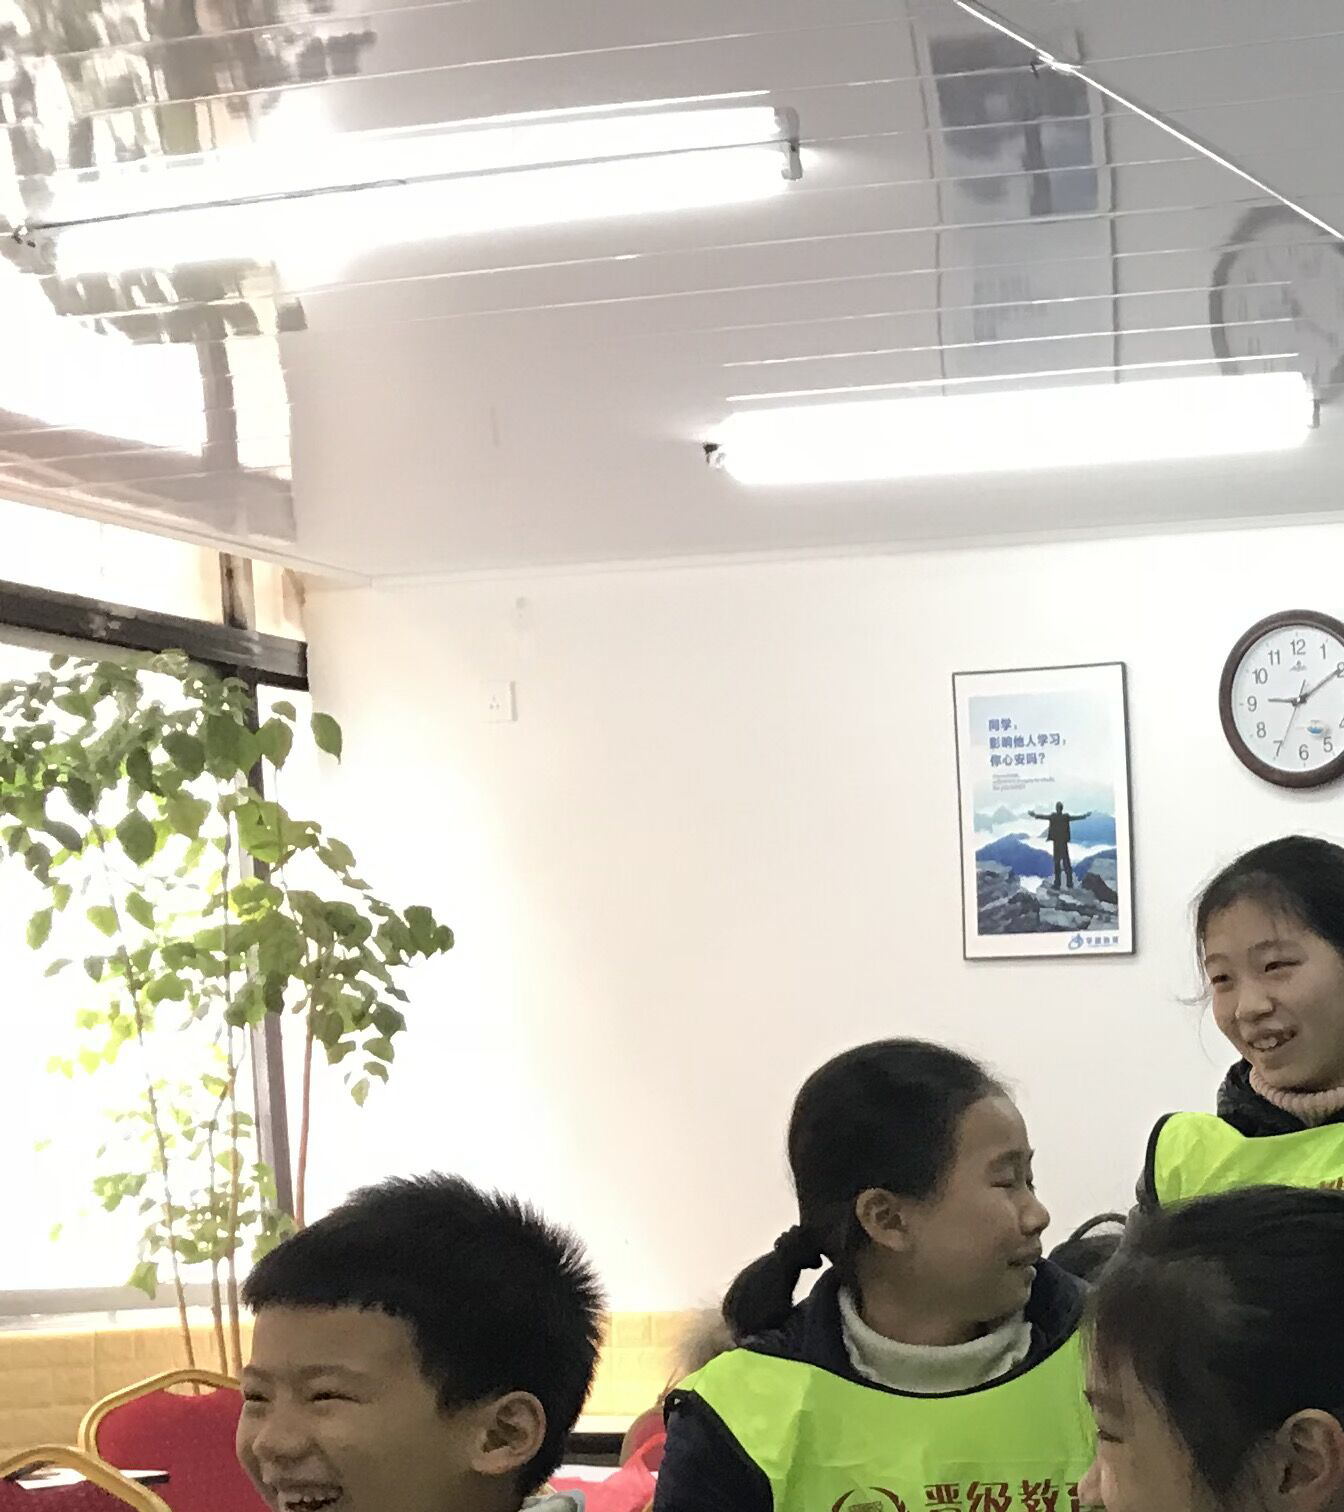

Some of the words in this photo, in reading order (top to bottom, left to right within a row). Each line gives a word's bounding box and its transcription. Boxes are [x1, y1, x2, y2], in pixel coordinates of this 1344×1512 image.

[1290, 639, 1306, 656] 12
[1320, 643, 1326, 659] 1
[1268, 650, 1281, 666] 11
[1252, 668, 1269, 684] 10
[1247, 696, 1258, 712] 9
[1256, 722, 1267, 738] 8
[1273, 740, 1284, 757] 7
[1300, 744, 1310, 760] 6
[1323, 737, 1334, 753] 5
